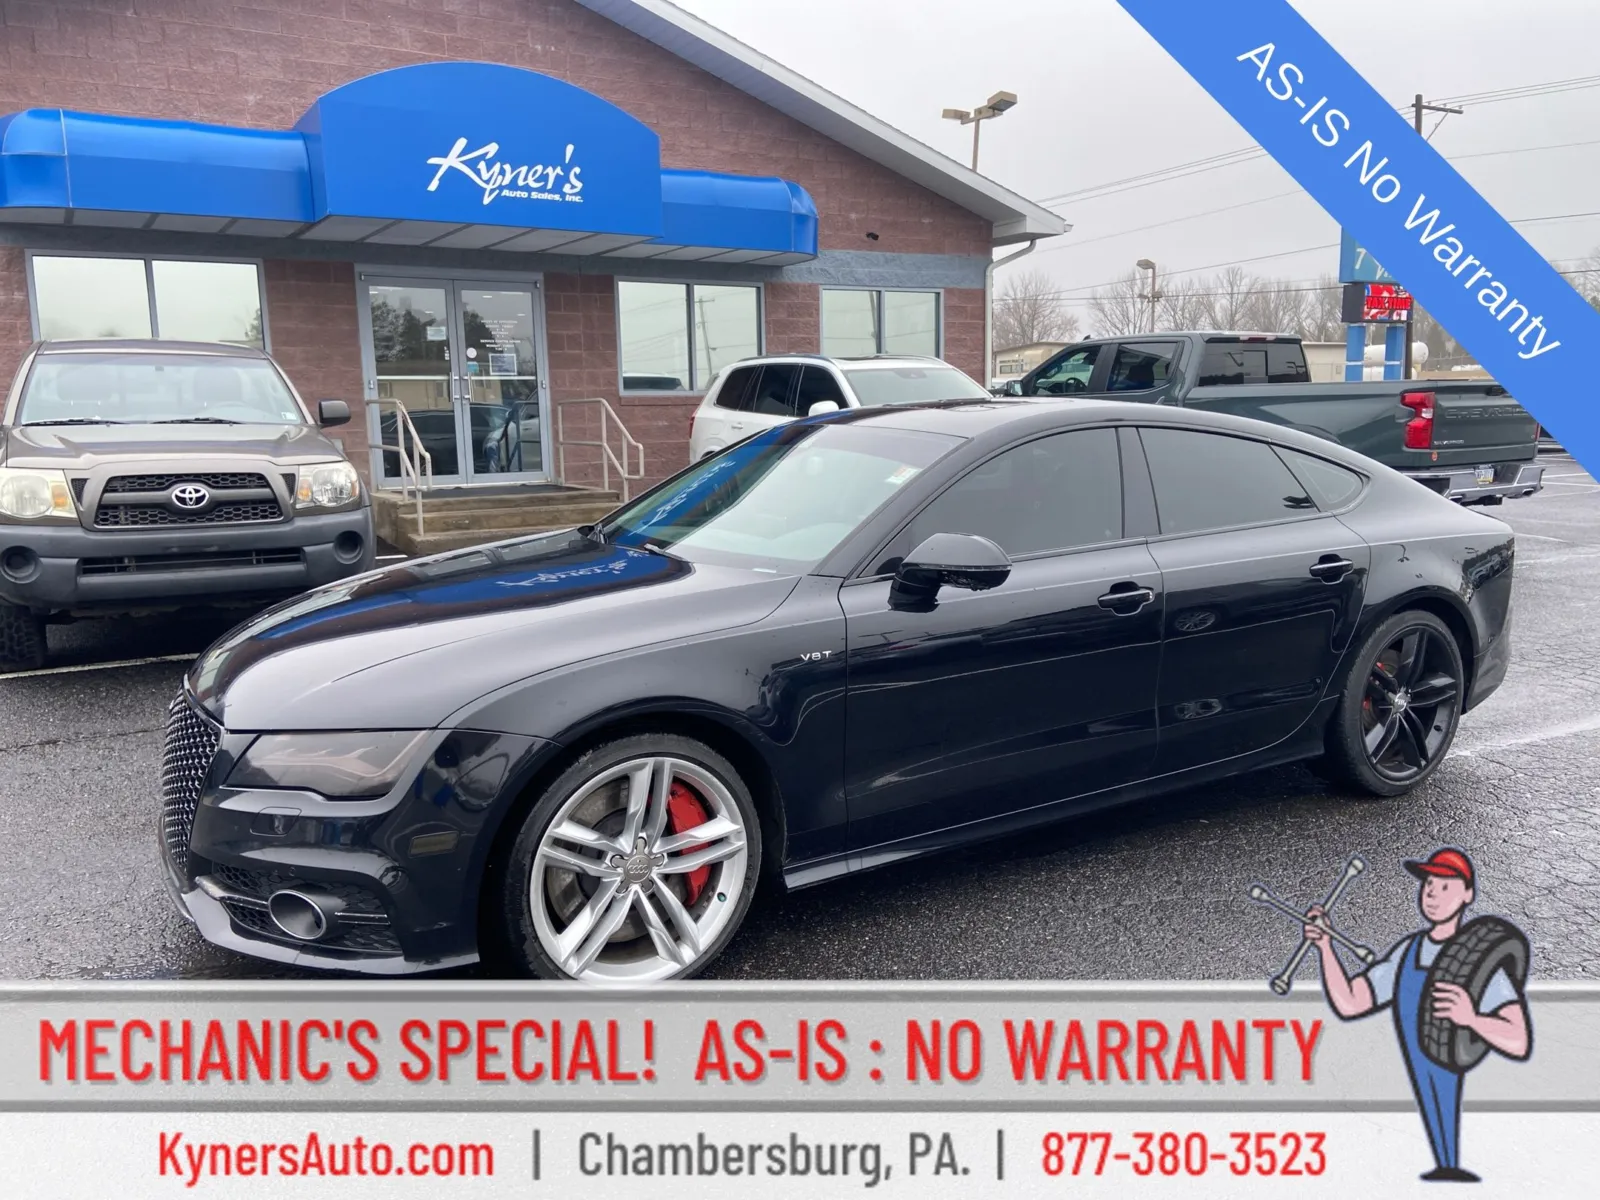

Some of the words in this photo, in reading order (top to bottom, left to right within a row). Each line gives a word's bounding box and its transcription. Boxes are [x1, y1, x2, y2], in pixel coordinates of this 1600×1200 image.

[426, 137, 583, 205] Kyner's
[501, 189, 529, 198] Auto
[531, 192, 563, 202] Sales,
[565, 194, 584, 203] Inc.
[800, 650, 832, 661] V8T
